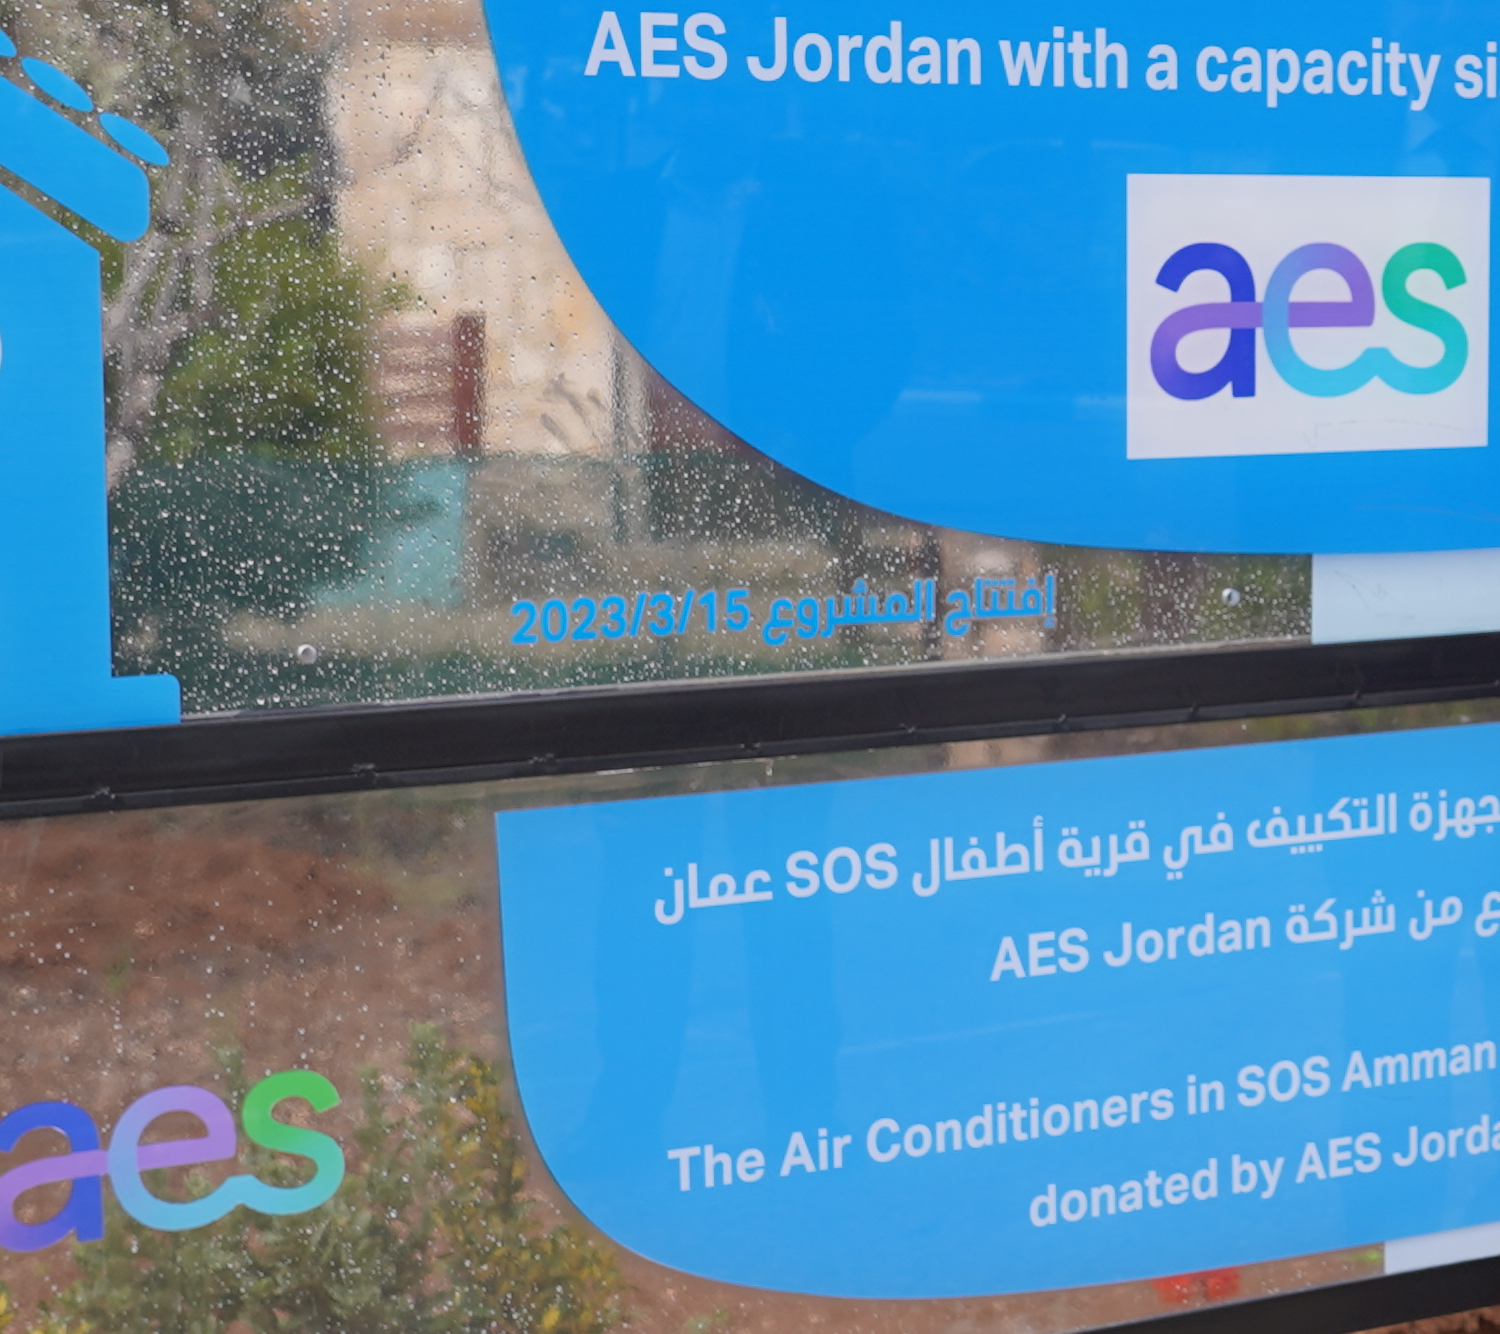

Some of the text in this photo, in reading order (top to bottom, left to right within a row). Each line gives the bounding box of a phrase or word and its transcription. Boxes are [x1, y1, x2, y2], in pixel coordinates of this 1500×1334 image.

[583, 10, 729, 81] AES
[745, 16, 982, 86] Jordan
[997, 25, 1129, 90] with
[1144, 43, 1179, 92] a
[1195, 36, 1443, 113] capacity
[1149, 240, 1471, 401] aes
[509, 588, 750, 645] 2023/3/15
[761, 579, 936, 646] المشروع
[911, 814, 1044, 898] أطفال
[1057, 819, 1151, 879] قرية
[1162, 811, 1235, 881] في
[1245, 792, 1398, 856] التكييف
[654, 862, 774, 926] عمان
[785, 842, 899, 899] SOS
[1102, 912, 1271, 968] Jordan
[1284, 889, 1396, 951] شركة
[1408, 889, 1464, 941] من
[989, 927, 1090, 983] AES
[666, 1143, 766, 1192] The
[779, 1127, 853, 1177] Air
[866, 1088, 1175, 1163] Conditioners
[1186, 1074, 1225, 1116] in
[1236, 1055, 1331, 1107] SOS
[1340, 1040, 1497, 1092] Amman
[1029, 1157, 1219, 1228] donated
[1231, 1153, 1285, 1200] by
[1295, 1131, 1382, 1184] AES
